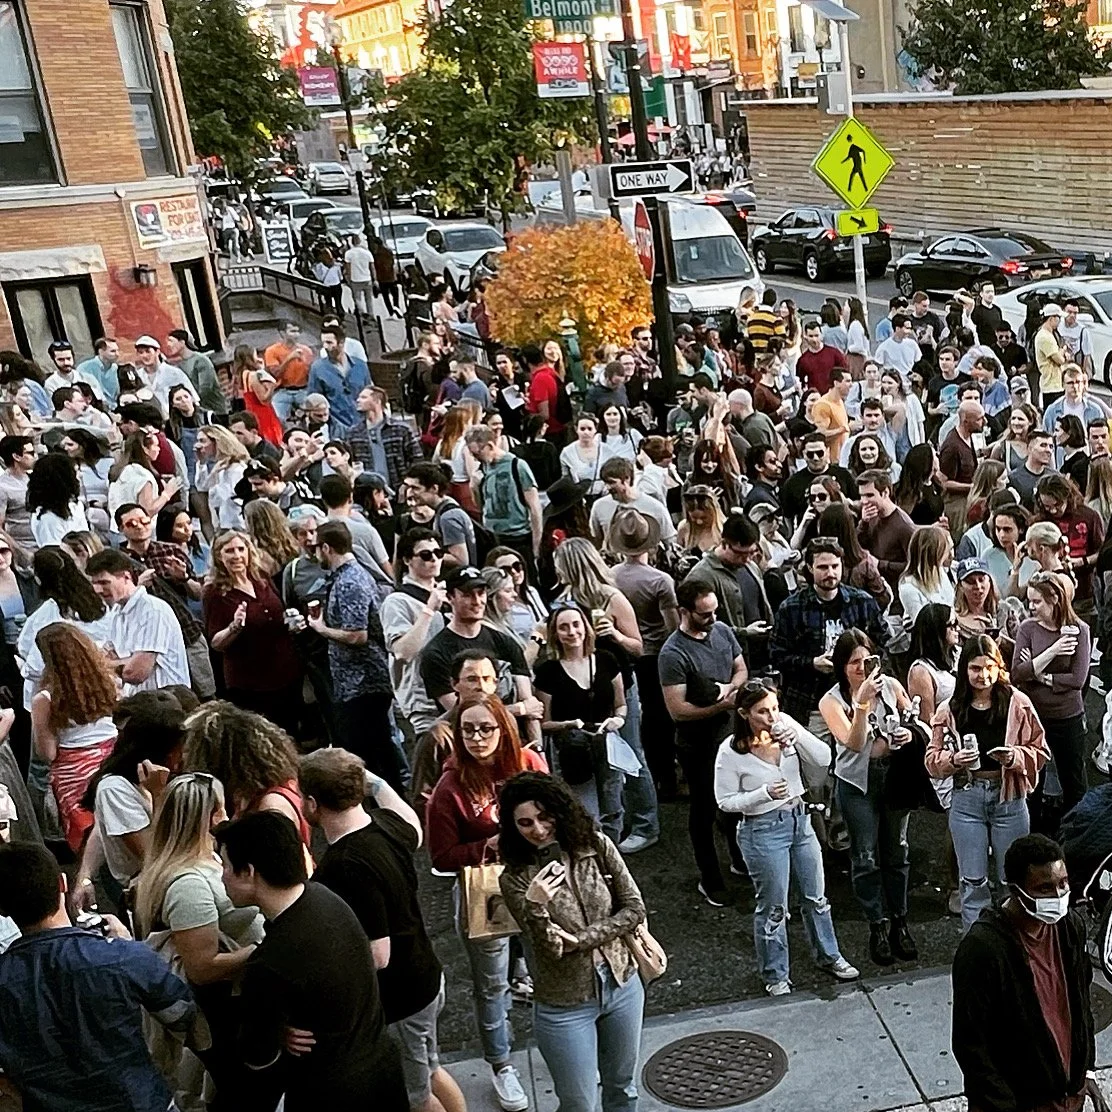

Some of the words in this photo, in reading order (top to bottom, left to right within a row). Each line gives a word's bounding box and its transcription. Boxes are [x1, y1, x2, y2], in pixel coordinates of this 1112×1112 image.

[531, 0, 597, 17] Belmont
[559, 20, 592, 34] 1800
[620, 174, 641, 188] ONE
[645, 172, 668, 186] WAY
